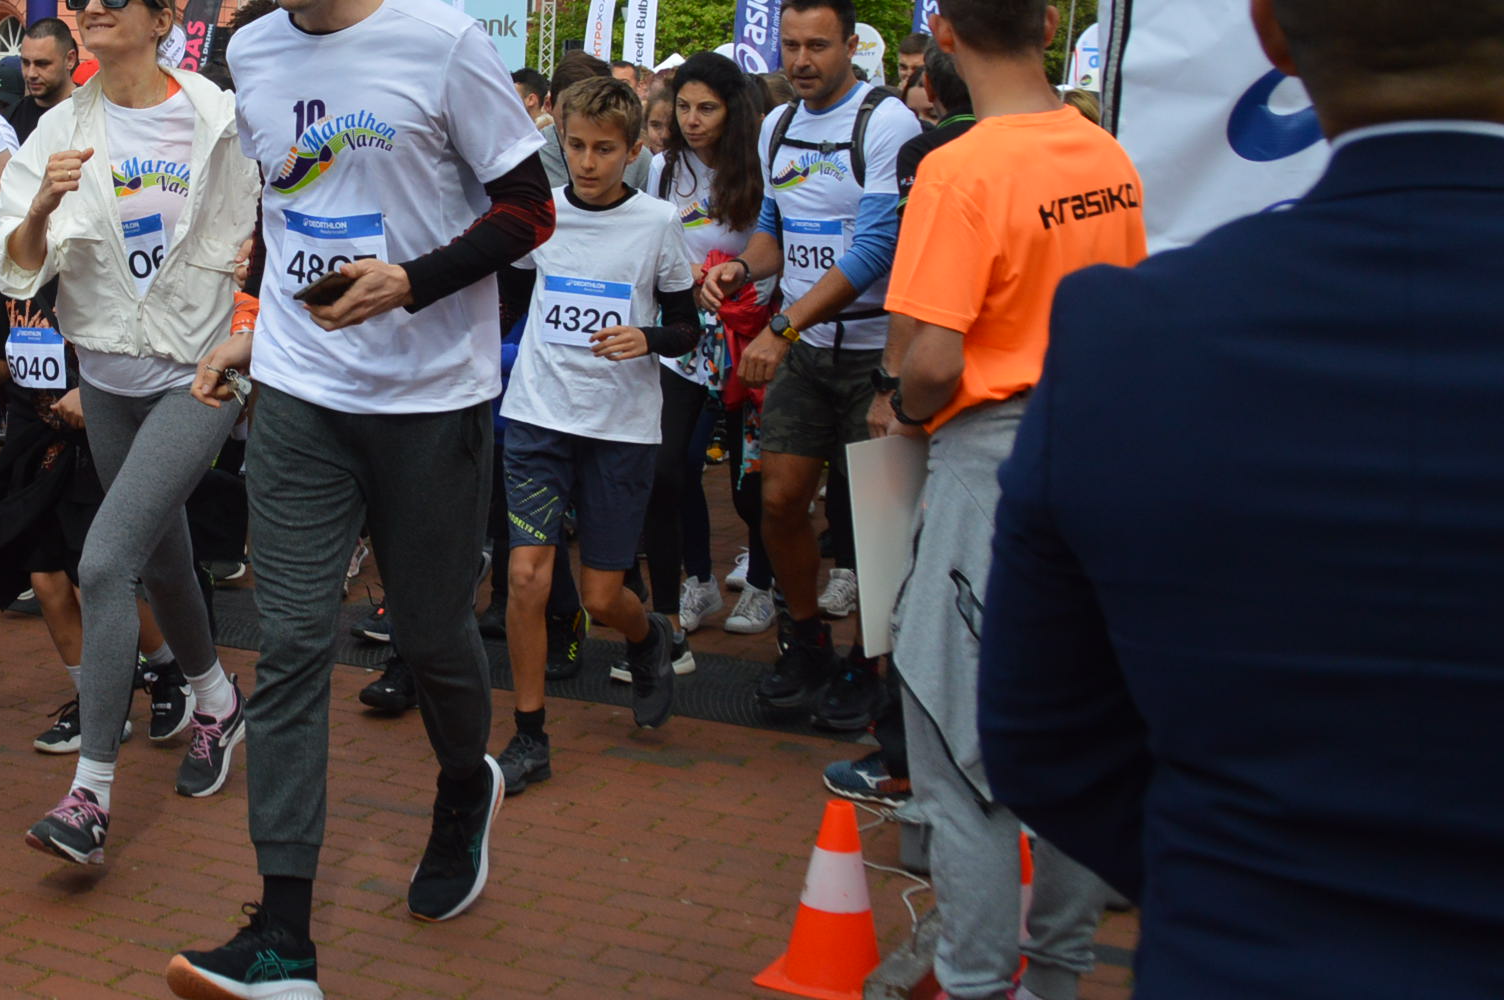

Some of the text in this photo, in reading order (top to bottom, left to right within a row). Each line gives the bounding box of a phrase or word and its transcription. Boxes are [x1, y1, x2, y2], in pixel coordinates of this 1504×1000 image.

[634, 32, 645, 65] redit
[292, 99, 326, 143] 10
[302, 109, 397, 154] Marathon
[342, 130, 394, 152] Varna
[787, 243, 836, 270] 4318
[7, 354, 60, 382] 5040
